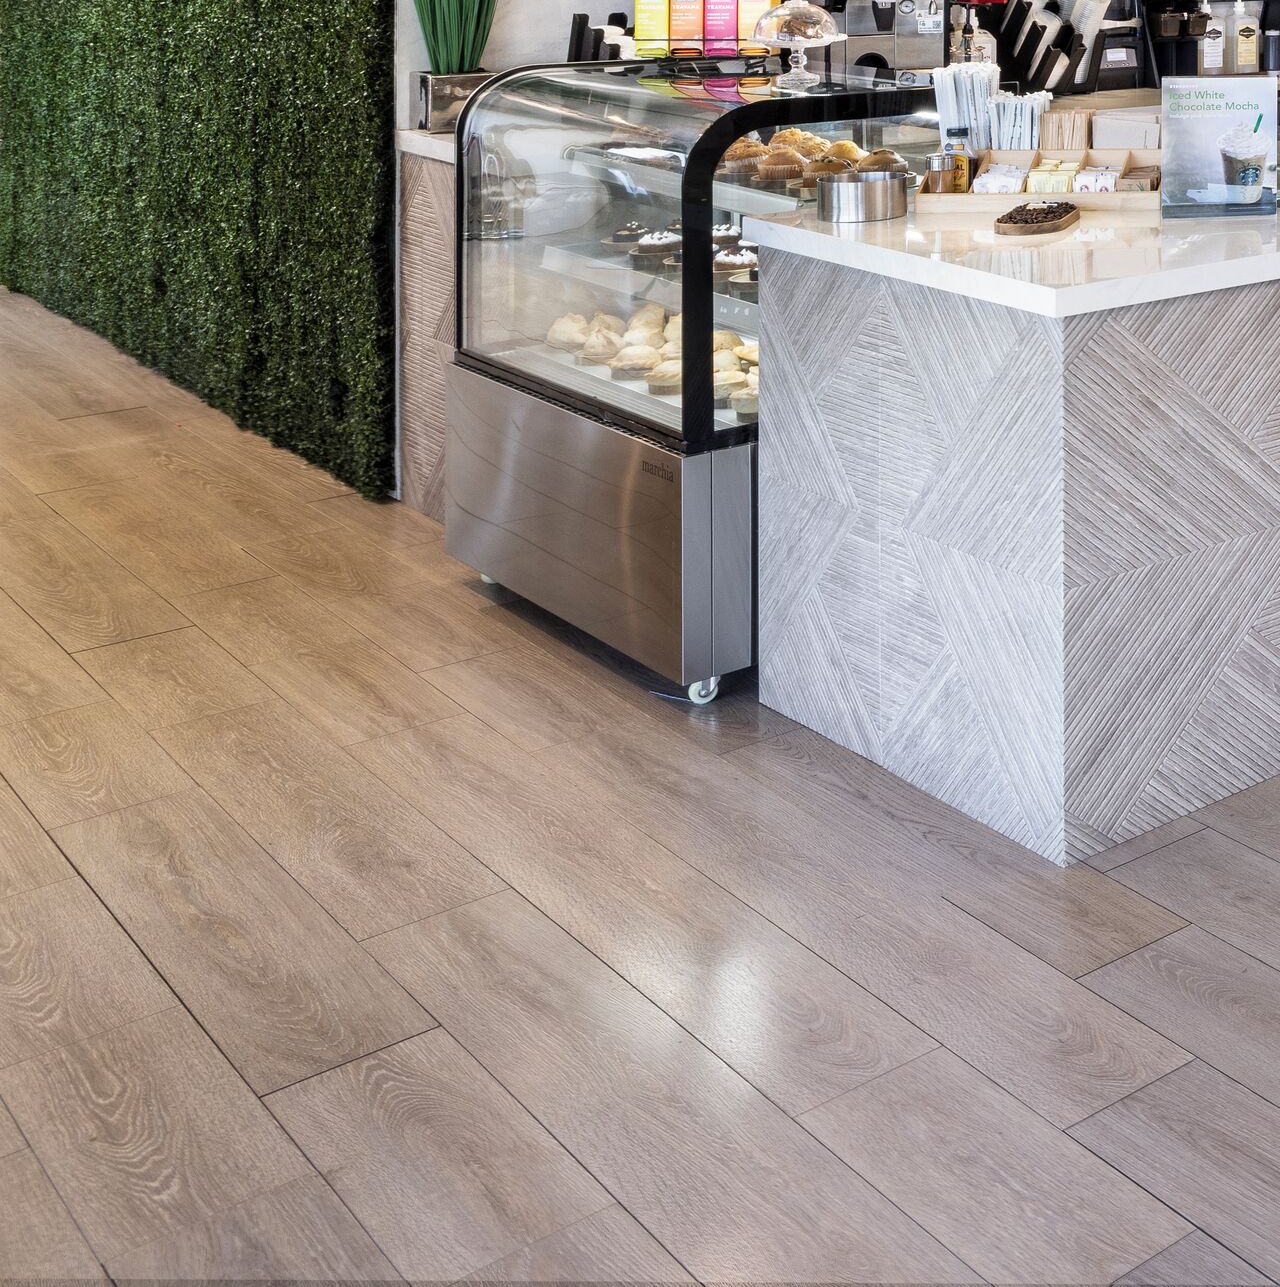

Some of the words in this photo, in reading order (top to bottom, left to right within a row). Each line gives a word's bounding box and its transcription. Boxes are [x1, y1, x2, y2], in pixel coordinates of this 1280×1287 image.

[1169, 91, 1191, 100] Iced
[1194, 90, 1225, 100] White
[1169, 102, 1222, 112] Chocolate
[1225, 101, 1260, 111] Mocha
[641, 460, 674, 483] marchia
